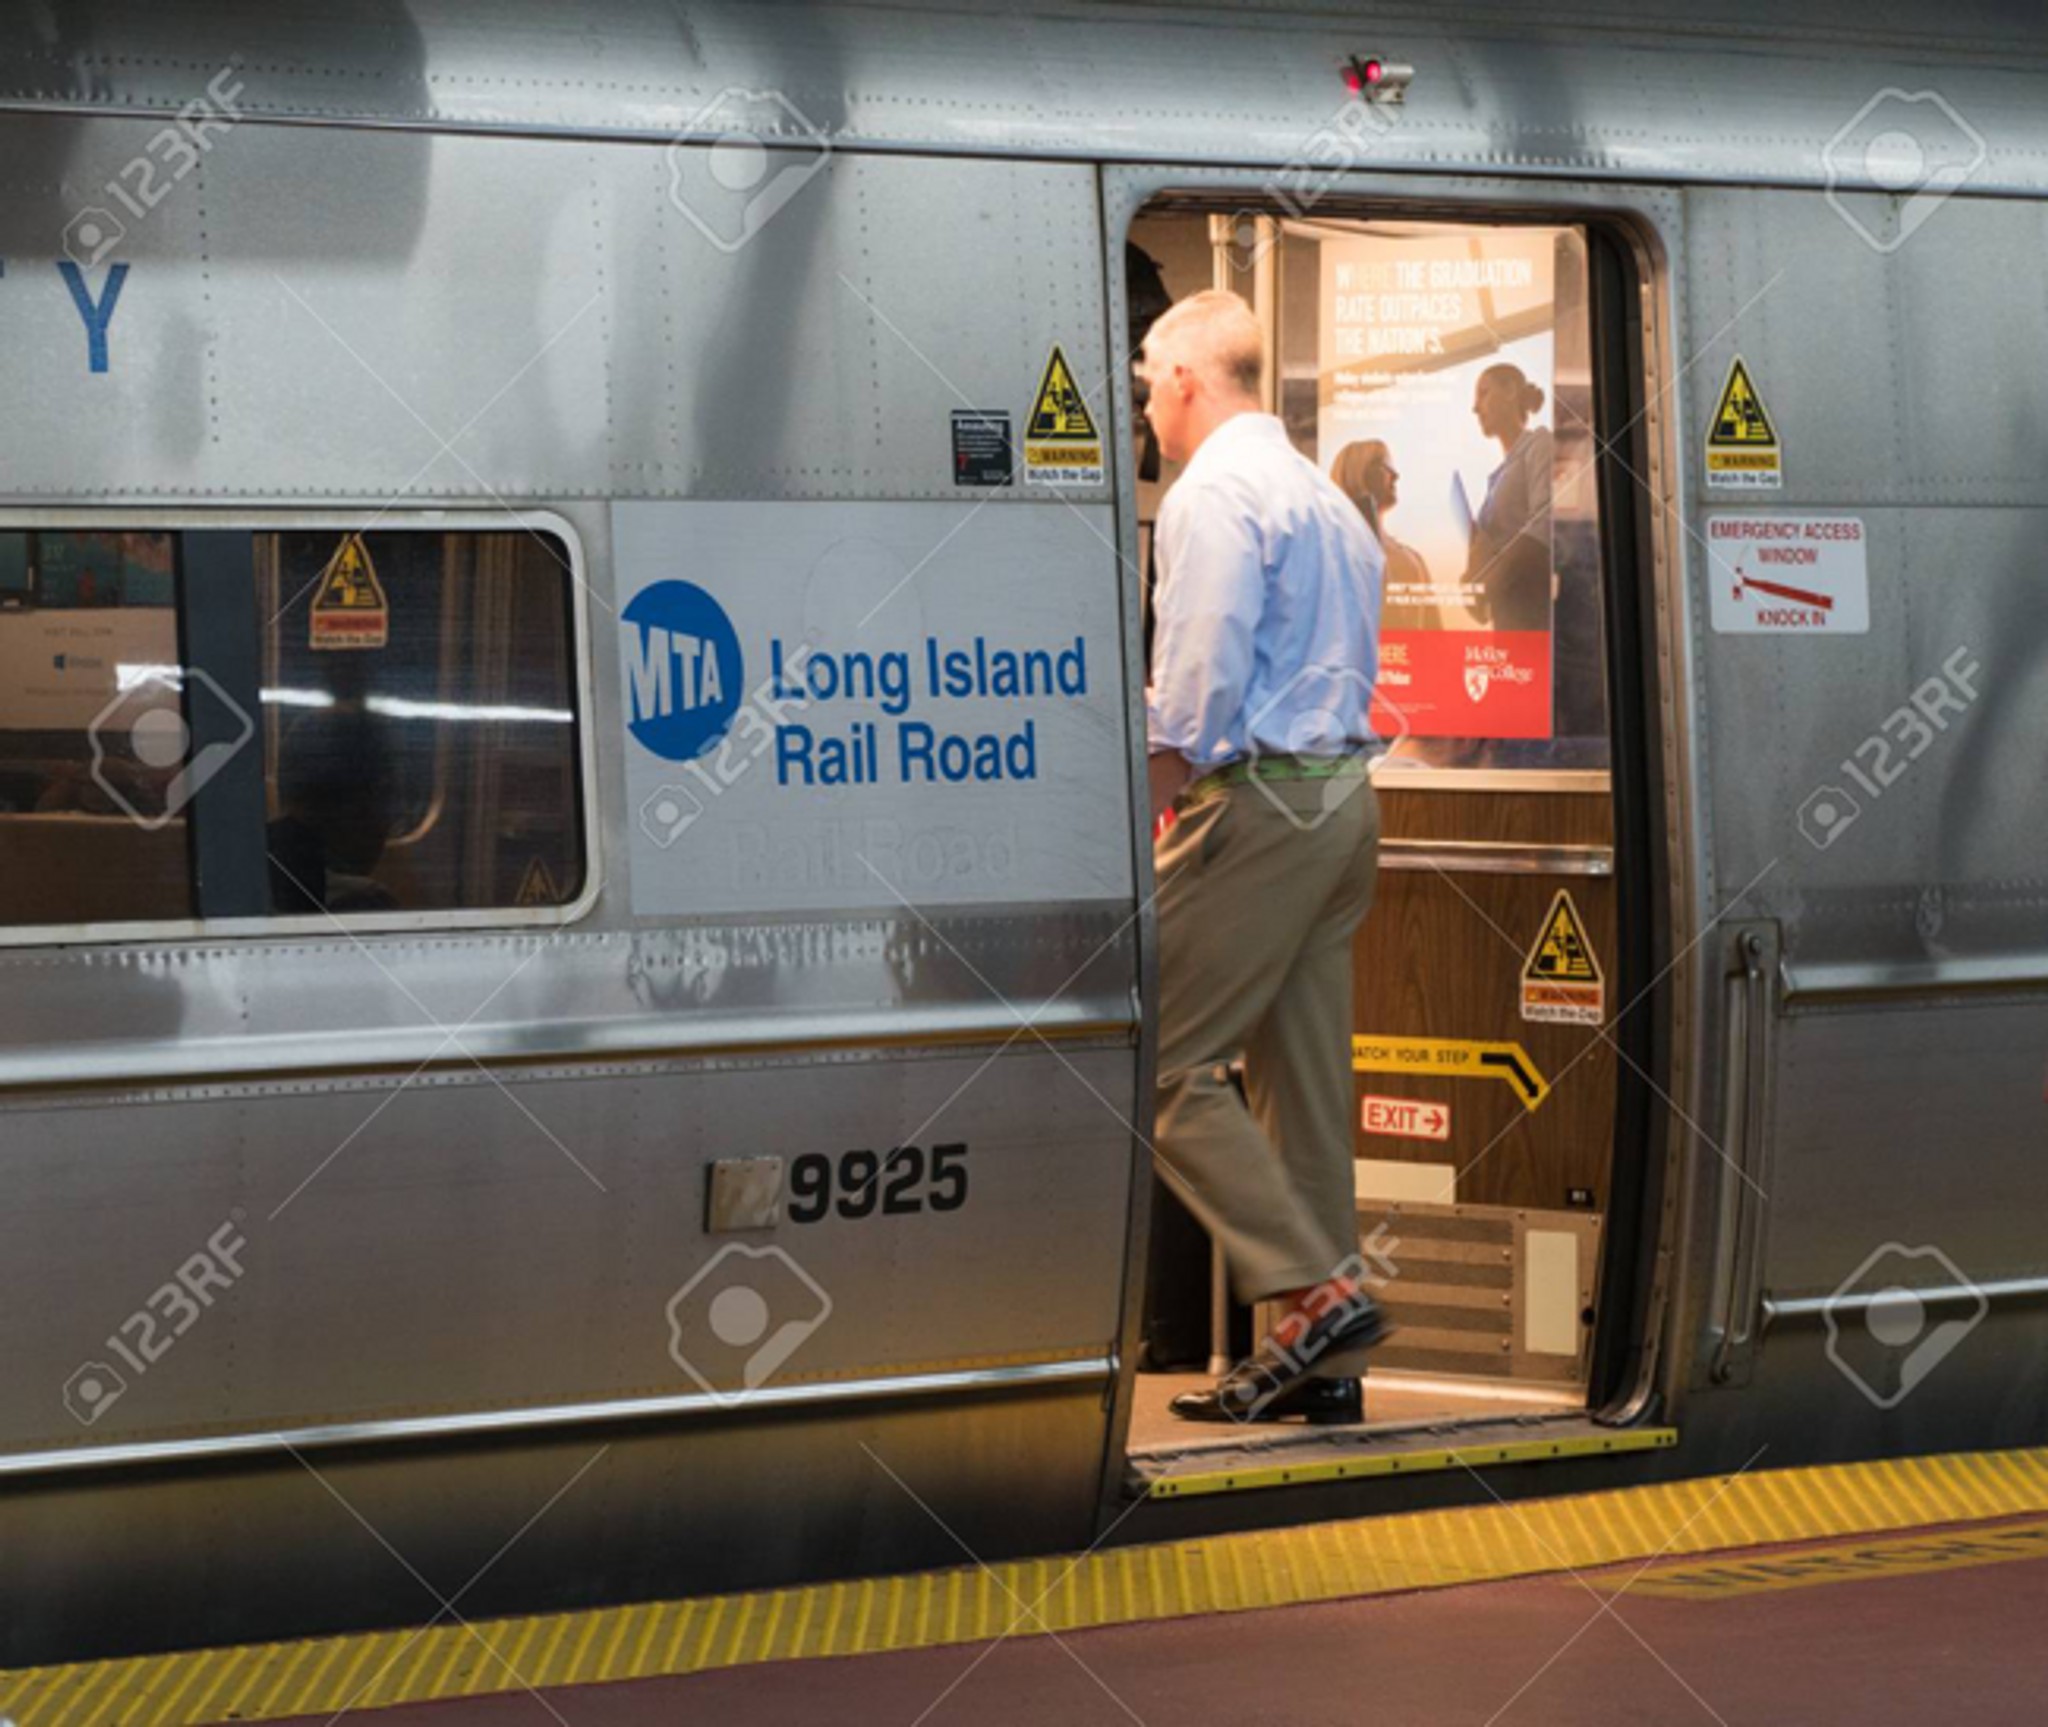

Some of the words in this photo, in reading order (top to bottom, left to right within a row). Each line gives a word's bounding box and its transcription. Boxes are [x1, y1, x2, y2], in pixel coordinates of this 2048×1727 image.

[1396, 260, 1426, 288] THE
[1430, 257, 1534, 288] GRADUATION
[1335, 294, 1375, 322] RATE
[1379, 293, 1462, 322] OUTPACES
[1335, 327, 1365, 354] THE
[1042, 448, 1099, 465] WARNING
[1723, 453, 1776, 467] WARNING
[1028, 468, 1060, 480] Watch
[1061, 469, 1079, 480] the
[1081, 467, 1101, 483] Gap
[1710, 472, 1741, 483] Watch
[1743, 472, 1757, 484] the
[1759, 472, 1779, 486] Gap
[1711, 520, 1800, 541] EMERGENCY
[1803, 522, 1862, 541] ACCESS
[1757, 546, 1820, 565] WINDOW
[1757, 609, 1809, 627] KNOCK
[1811, 610, 1826, 627] IN
[620, 618, 724, 724] MTA
[771, 639, 911, 716] Long
[926, 636, 1087, 697] Island
[775, 721, 878, 786] Rail
[899, 719, 1038, 783] Road
[1540, 987, 1599, 1003] WARNING
[1525, 1005, 1557, 1018] Watch
[1559, 1006, 1577, 1019] the
[1578, 1007, 1600, 1022] Gap
[1396, 1048, 1431, 1063] YOUR
[1436, 1050, 1470, 1064] STEP
[1367, 1102, 1419, 1131] EXIT
[788, 1143, 968, 1224] 9925
